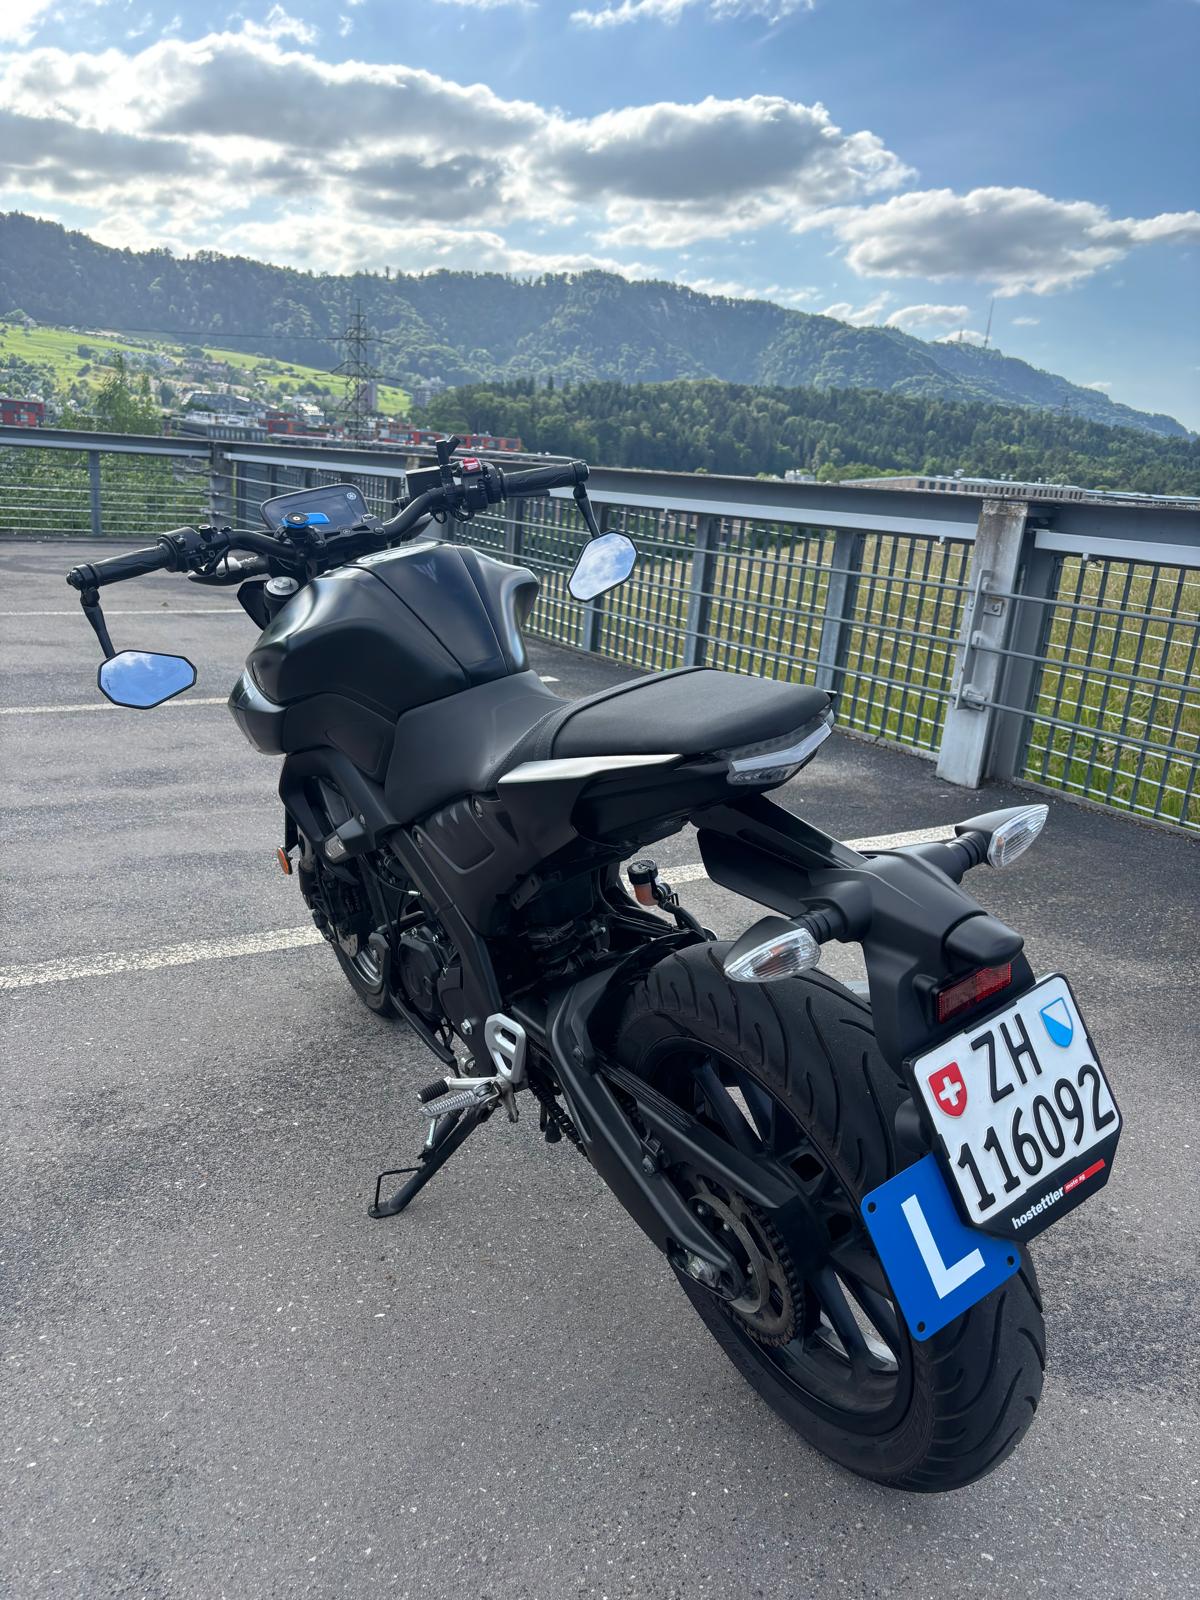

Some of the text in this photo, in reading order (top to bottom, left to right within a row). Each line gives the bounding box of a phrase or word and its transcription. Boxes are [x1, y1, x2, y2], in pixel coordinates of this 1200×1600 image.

[970, 1013, 1042, 1103] ZH
[957, 1064, 1115, 1211] 116092
[901, 1194, 985, 1299] L
[1012, 1187, 1064, 1229] hostettler
